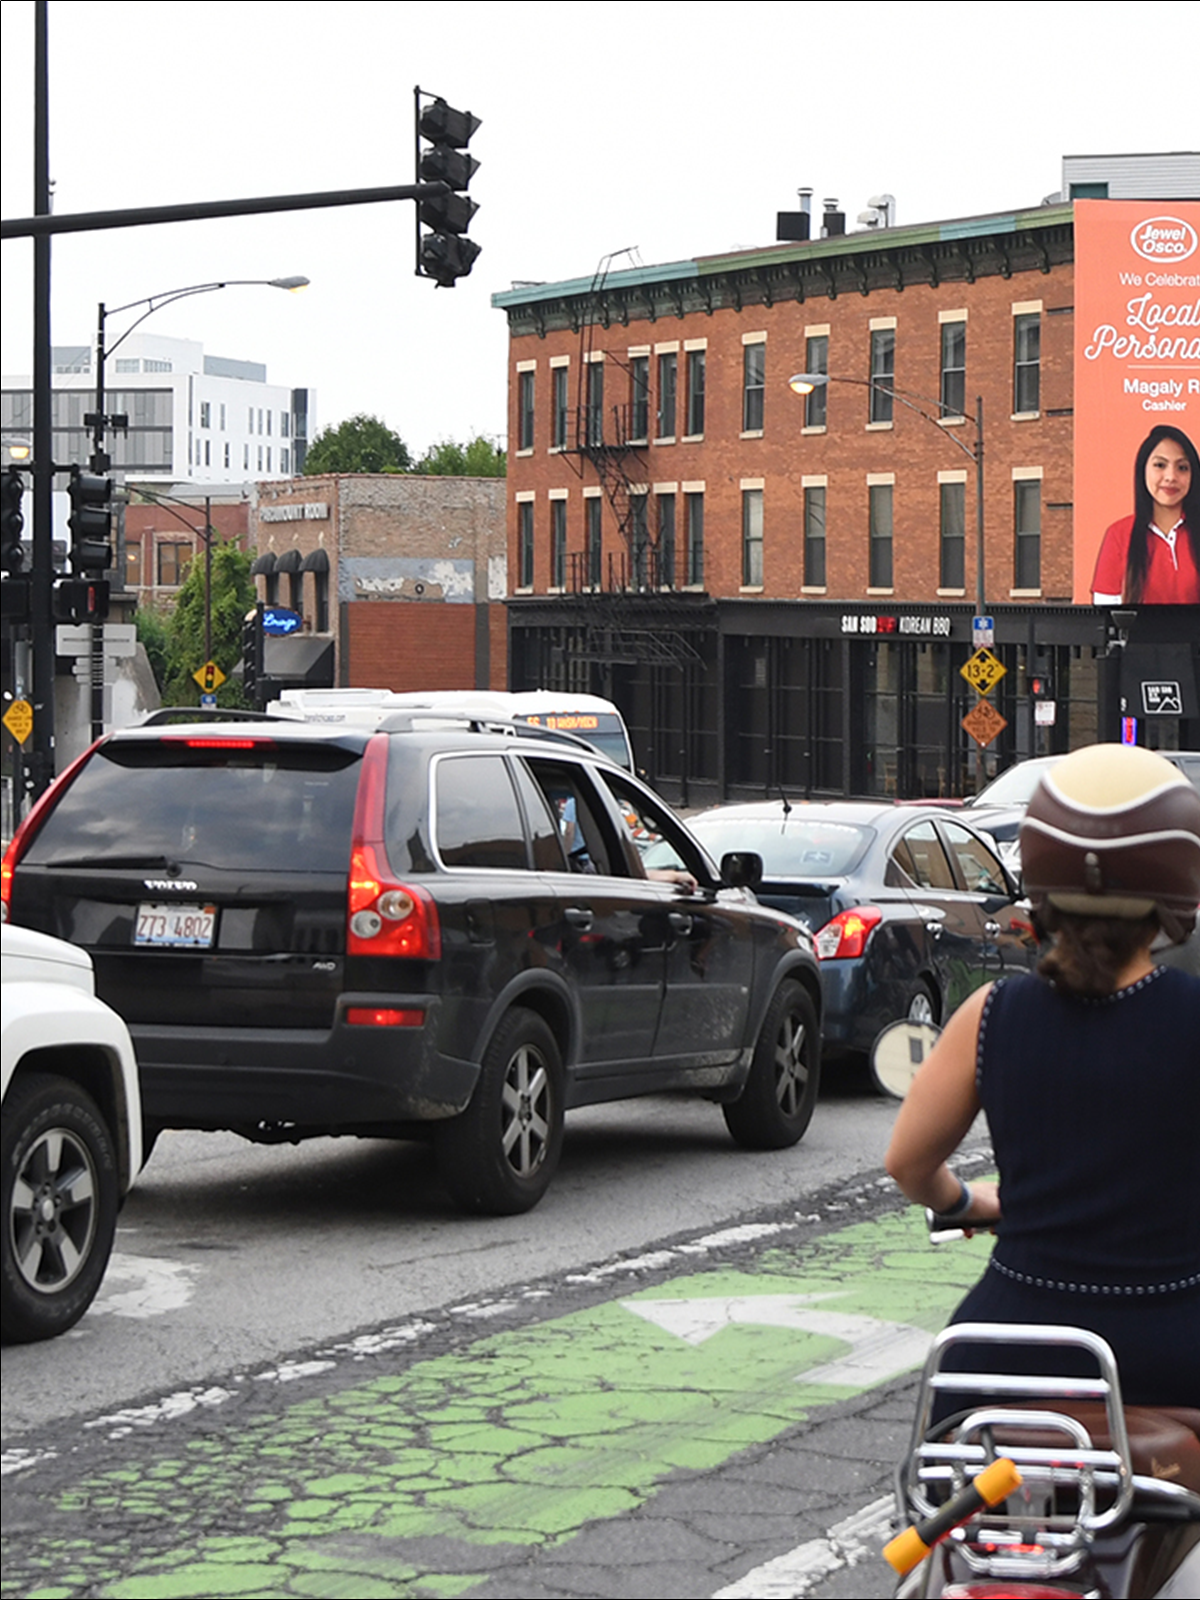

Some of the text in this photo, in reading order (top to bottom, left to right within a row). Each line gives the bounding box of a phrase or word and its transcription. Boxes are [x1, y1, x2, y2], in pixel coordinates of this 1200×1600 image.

[1140, 225, 1186, 240] Jewel
[1142, 239, 1185, 253] Osco
[1119, 272, 1142, 287] We
[1123, 378, 1183, 397] Magaly
[1142, 399, 1186, 411] Cashier
[304, 502, 328, 519] ROOM
[841, 615, 859, 633] SAN
[860, 615, 877, 633] SOO
[899, 616, 932, 634] KOREAN
[933, 616, 950, 636] BBQ
[144, 880, 198, 890] VOLVO
[137, 915, 212, 939] Z73 4802
